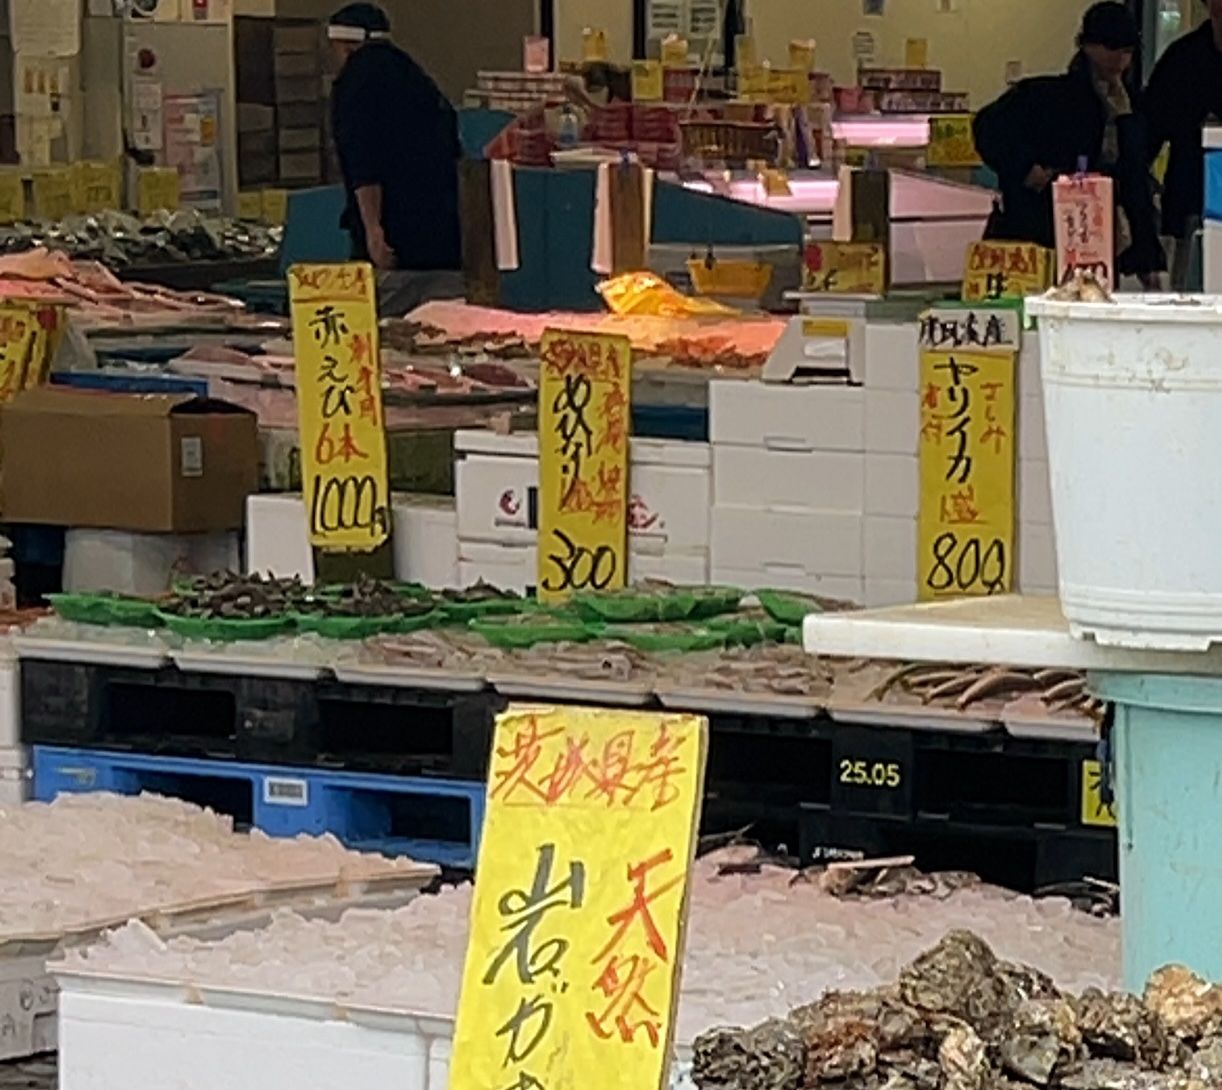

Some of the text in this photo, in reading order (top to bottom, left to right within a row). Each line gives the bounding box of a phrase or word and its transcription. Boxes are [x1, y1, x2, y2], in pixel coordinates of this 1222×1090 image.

[315, 422, 369, 465] 6本
[932, 356, 979, 484] ヤリイカ
[541, 528, 616, 592] 300
[839, 759, 900, 788] 25.05
[586, 848, 686, 1048] 天然
